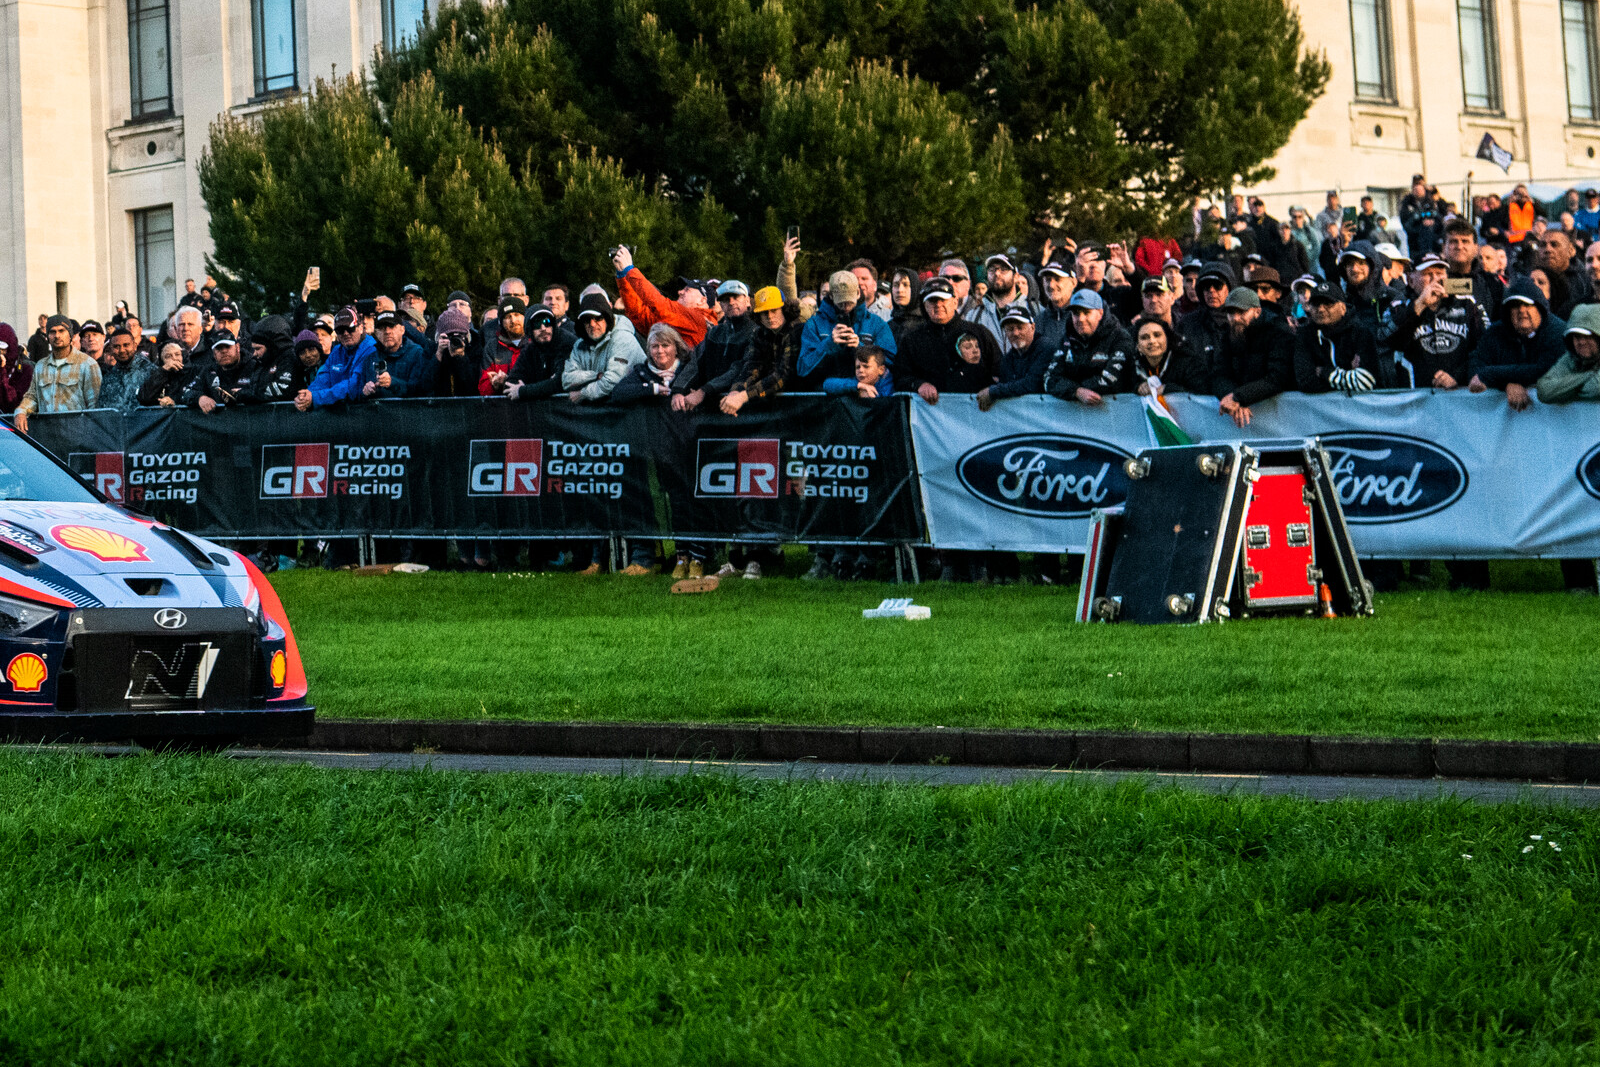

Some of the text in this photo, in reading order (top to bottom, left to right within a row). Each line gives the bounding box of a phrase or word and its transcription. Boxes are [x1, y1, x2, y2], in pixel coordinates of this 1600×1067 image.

[334, 444, 411, 460] TOYOTA
[547, 441, 630, 457] TOYOTA
[786, 441, 877, 460] TOYOTA
[128, 452, 207, 468] TOYOTA
[547, 460, 624, 476] GAZOO
[129, 469, 200, 485] GAZOO
[333, 463, 405, 477] GAZOO
[472, 462, 538, 492] GR
[700, 462, 776, 493] GR
[786, 461, 869, 479] GAZOO
[997, 446, 1111, 503] Ford
[263, 465, 326, 495] GR
[333, 480, 403, 499] Racing
[547, 478, 622, 499] Racing
[129, 485, 198, 504] Racing
[785, 480, 869, 503] Racing
